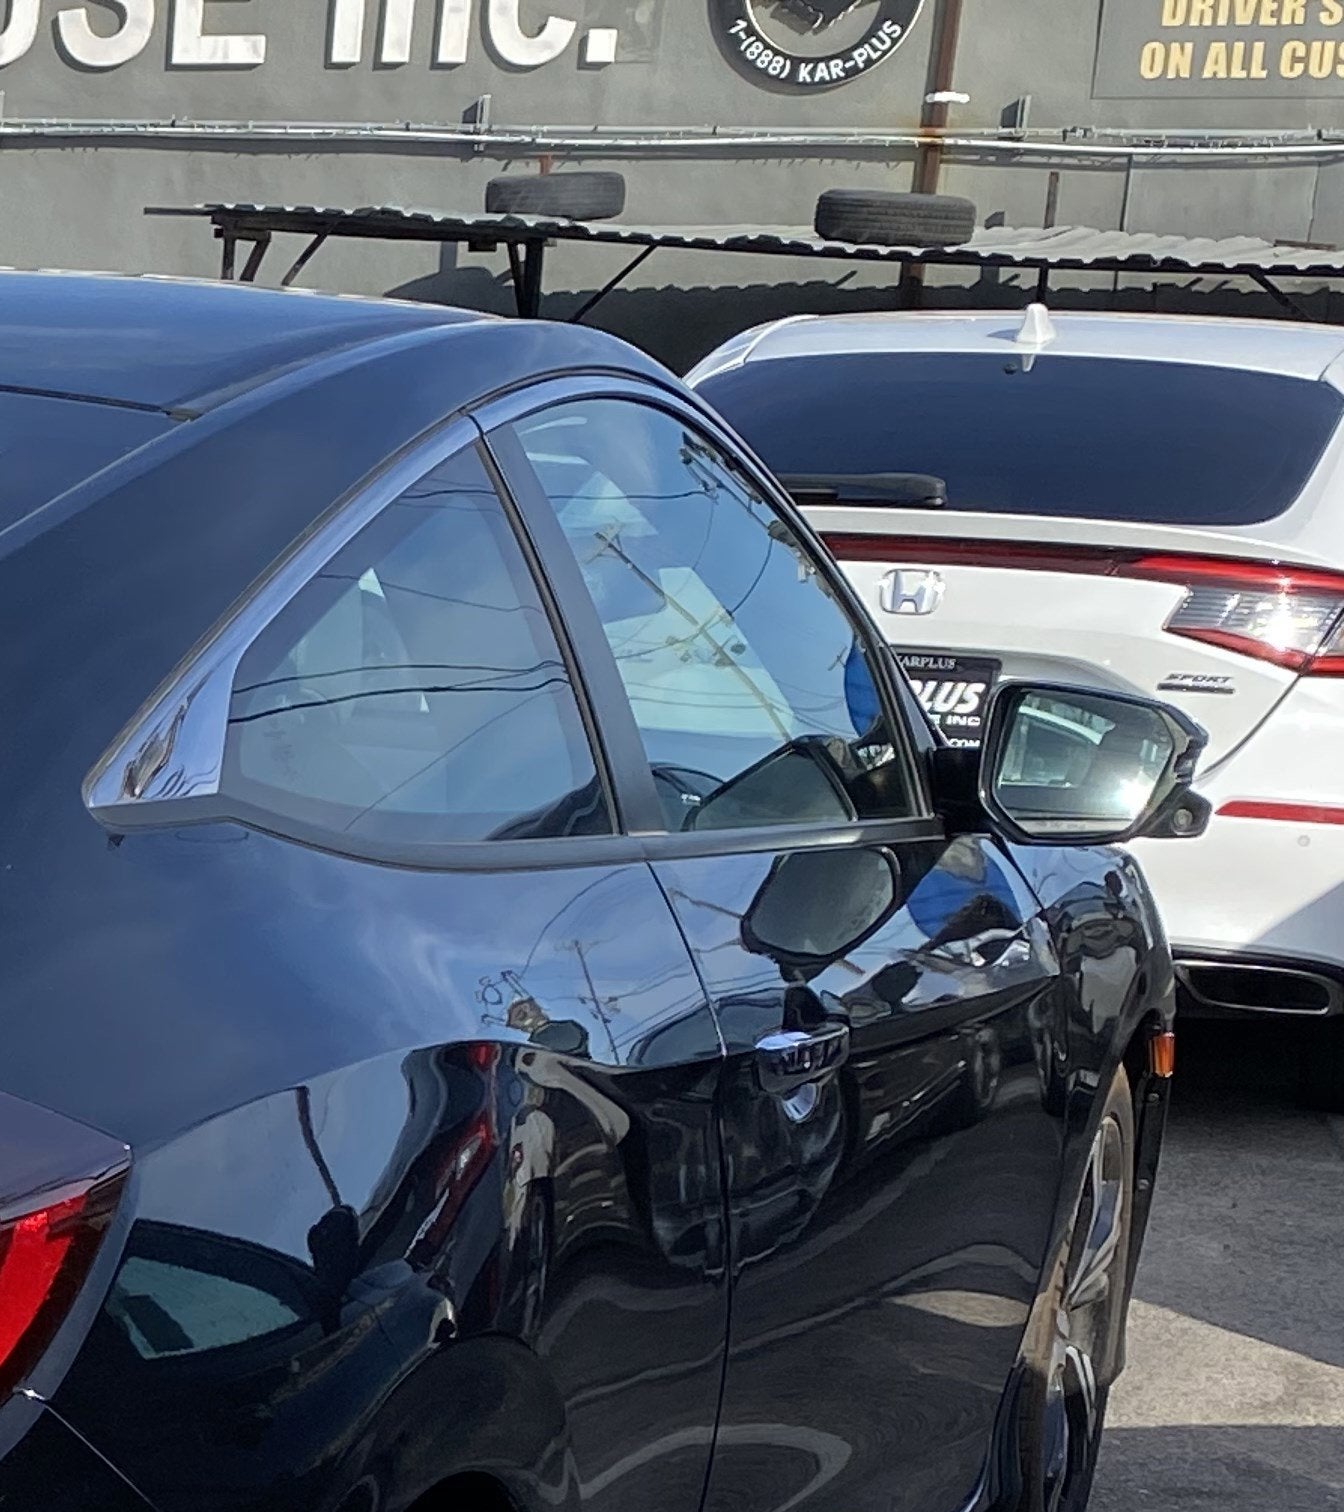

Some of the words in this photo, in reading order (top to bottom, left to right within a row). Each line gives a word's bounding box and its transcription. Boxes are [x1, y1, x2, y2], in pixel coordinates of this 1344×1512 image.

[728, 18, 791, 79] 1-(888)
[798, 19, 903, 83] KAR-PLUS
[1140, 41, 1194, 79] ON
[1202, 41, 1268, 79] ALL
